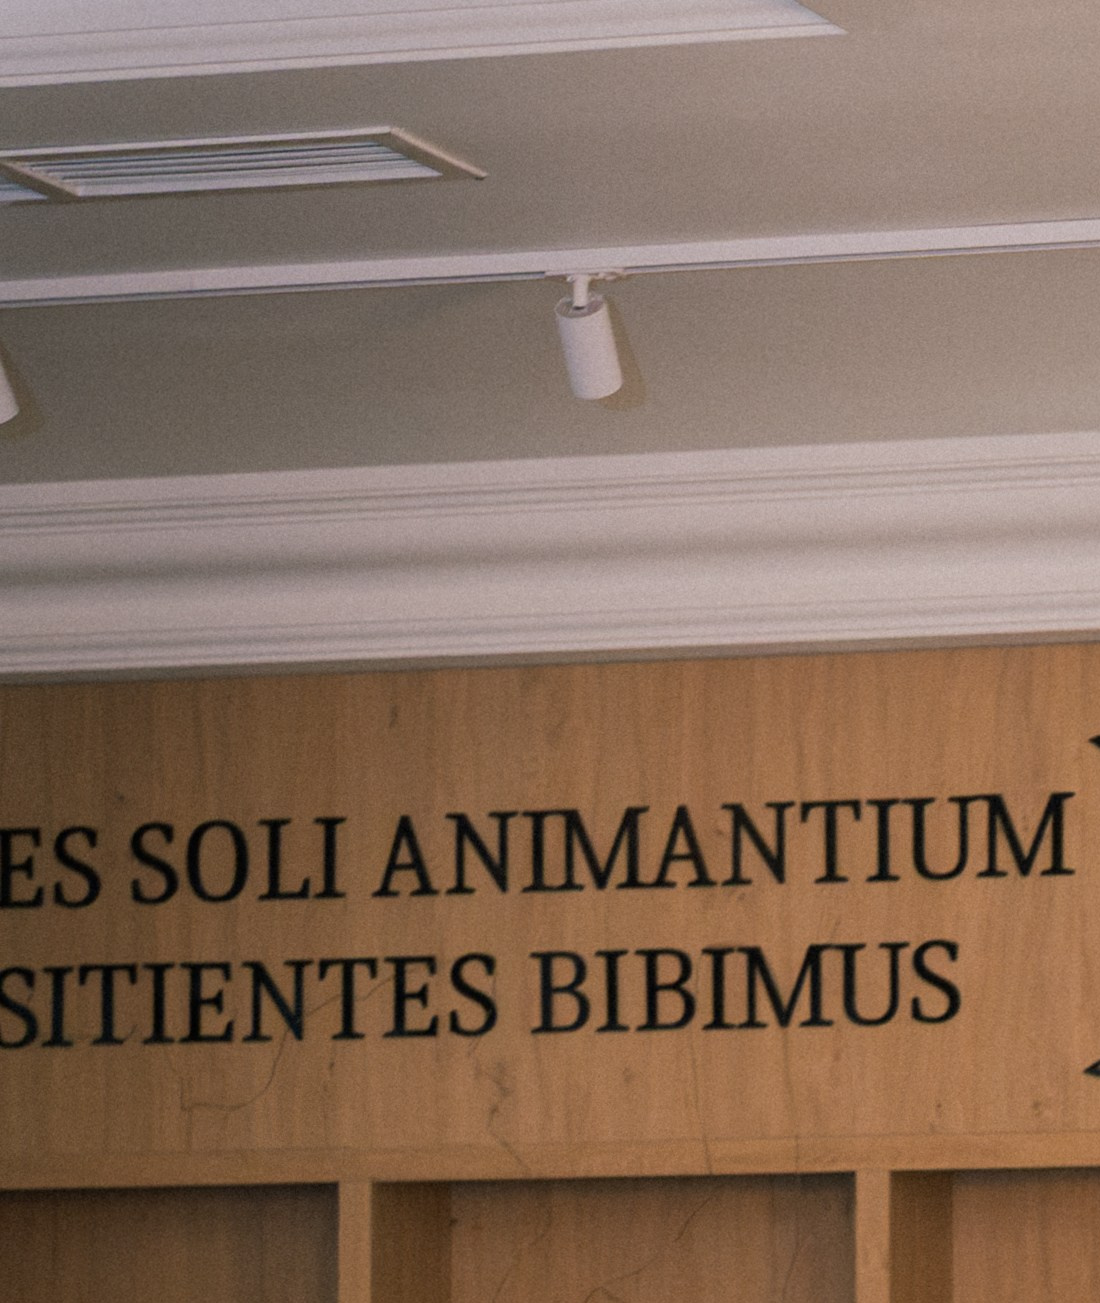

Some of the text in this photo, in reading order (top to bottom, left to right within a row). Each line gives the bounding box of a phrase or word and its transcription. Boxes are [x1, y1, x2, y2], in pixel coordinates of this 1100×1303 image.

[0, 791, 1076, 909] ES SOLI ANIMANTIUM
[0, 940, 961, 1049] SITIENTES BIBIMUS
